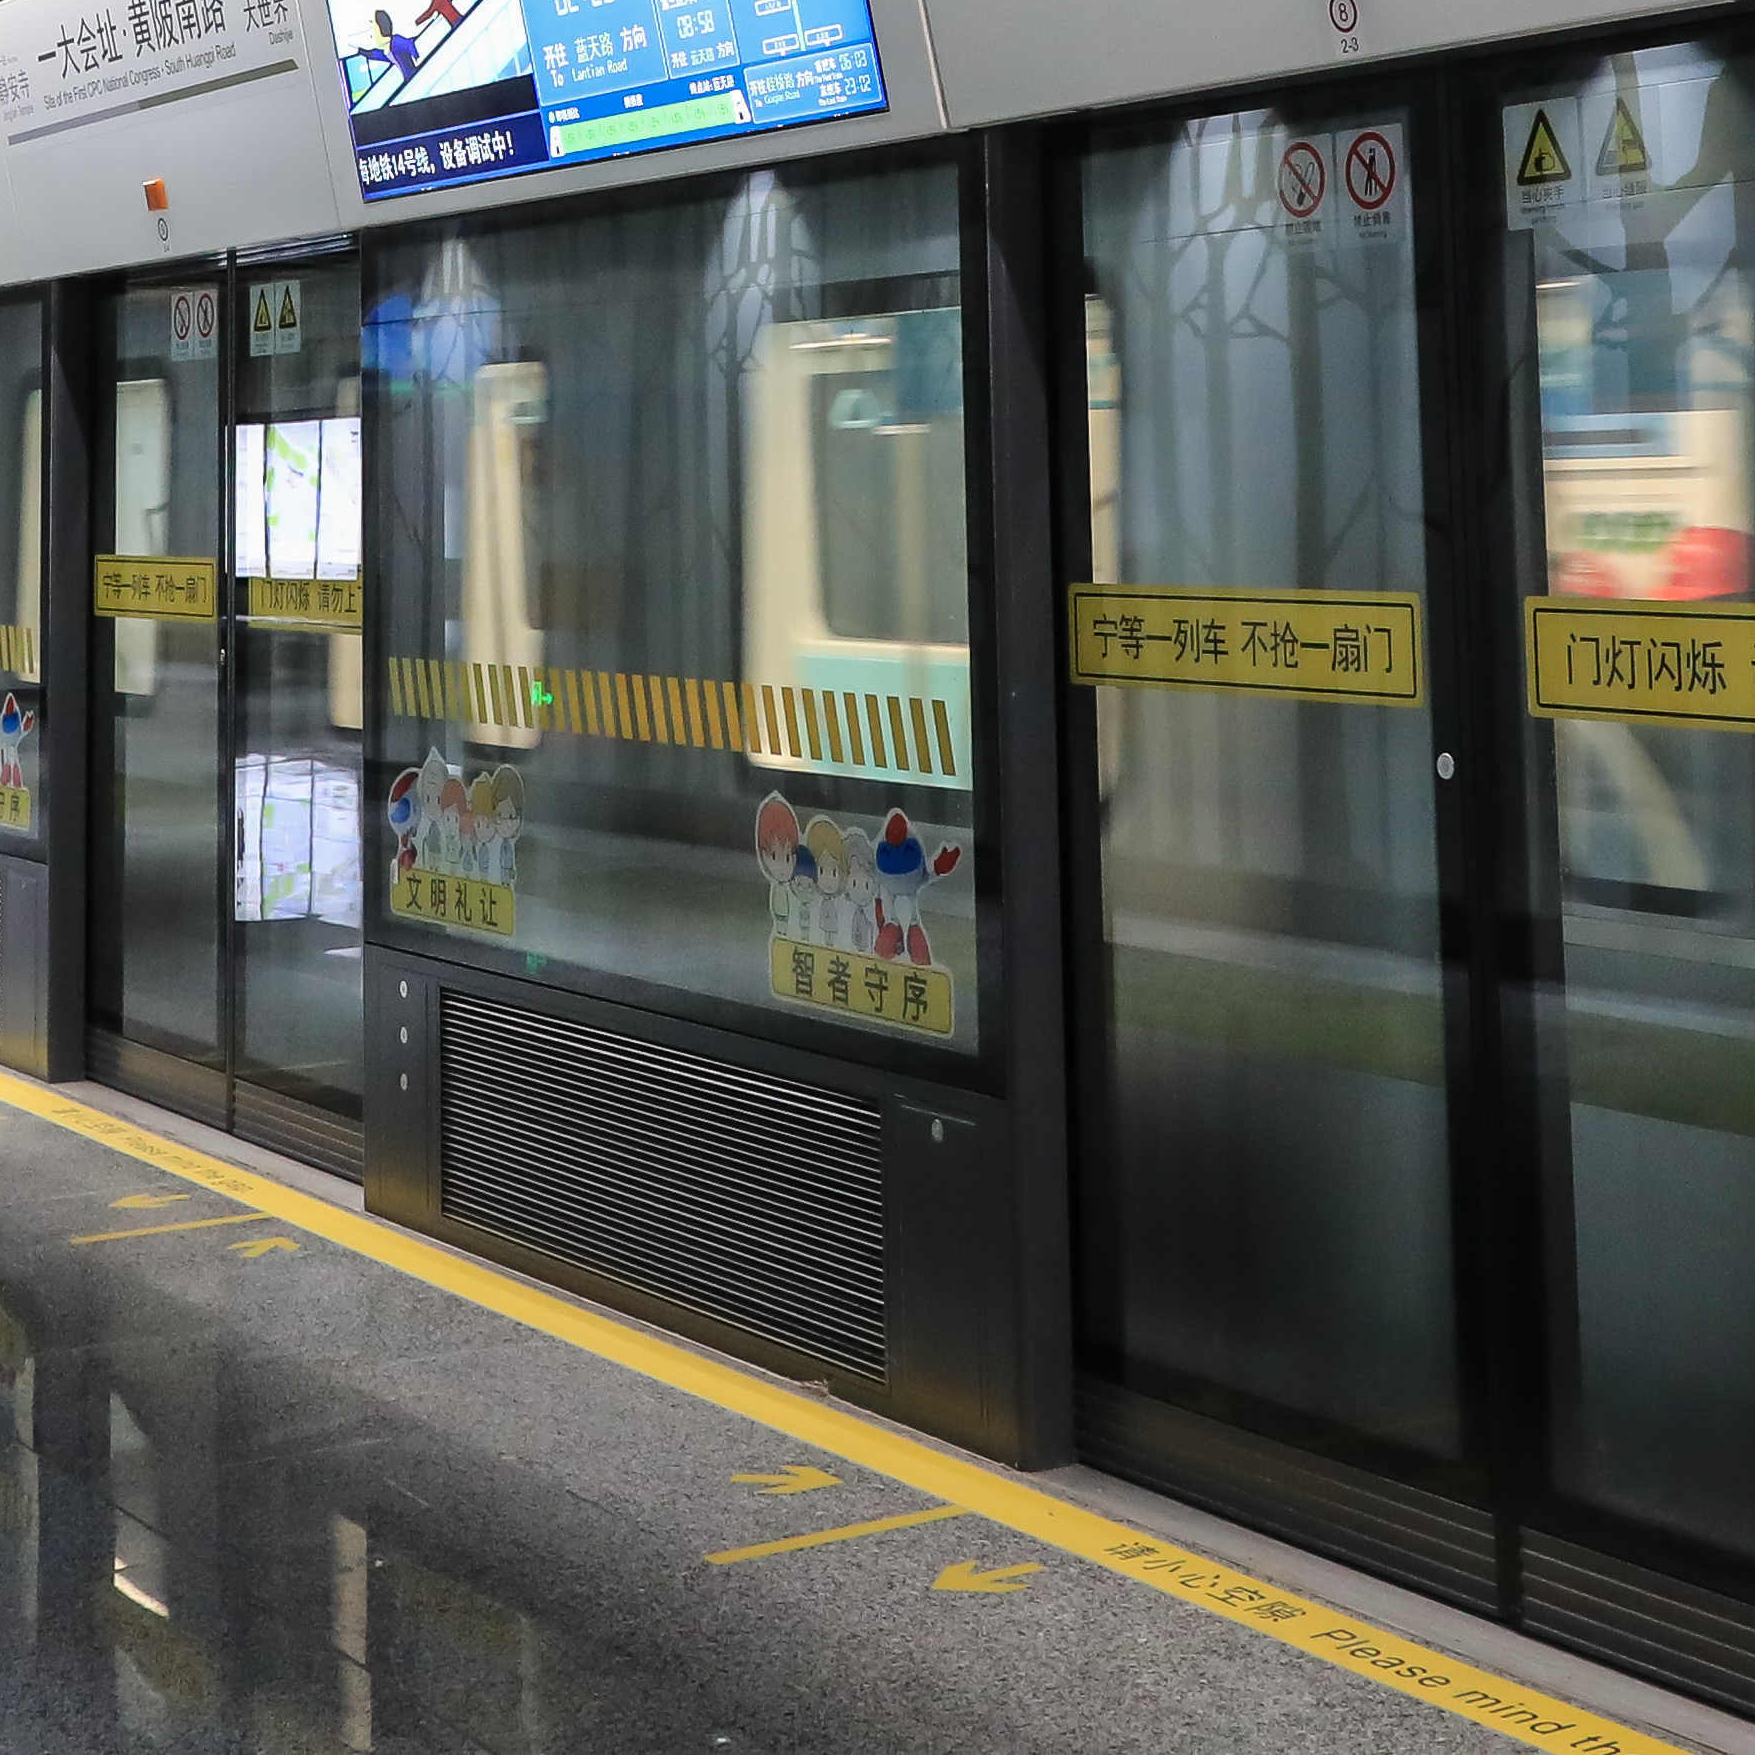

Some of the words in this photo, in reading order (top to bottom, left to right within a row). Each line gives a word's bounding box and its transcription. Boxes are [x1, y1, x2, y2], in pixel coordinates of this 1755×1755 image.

[620, 24, 648, 52] 方向
[318, 582, 362, 614] 请勿上
[1093, 614, 1229, 666] 宁等一列车
[1240, 620, 1393, 675] 不抢一扇门
[1565, 633, 1727, 696] 门灯闪烁
[405, 873, 500, 929] 文明礼让
[791, 947, 928, 1022] 智者守序
[1103, 1542, 1308, 1624] 请小心空隙
[1313, 1628, 1451, 1689] Please
[1455, 1688, 1578, 1736] mind
